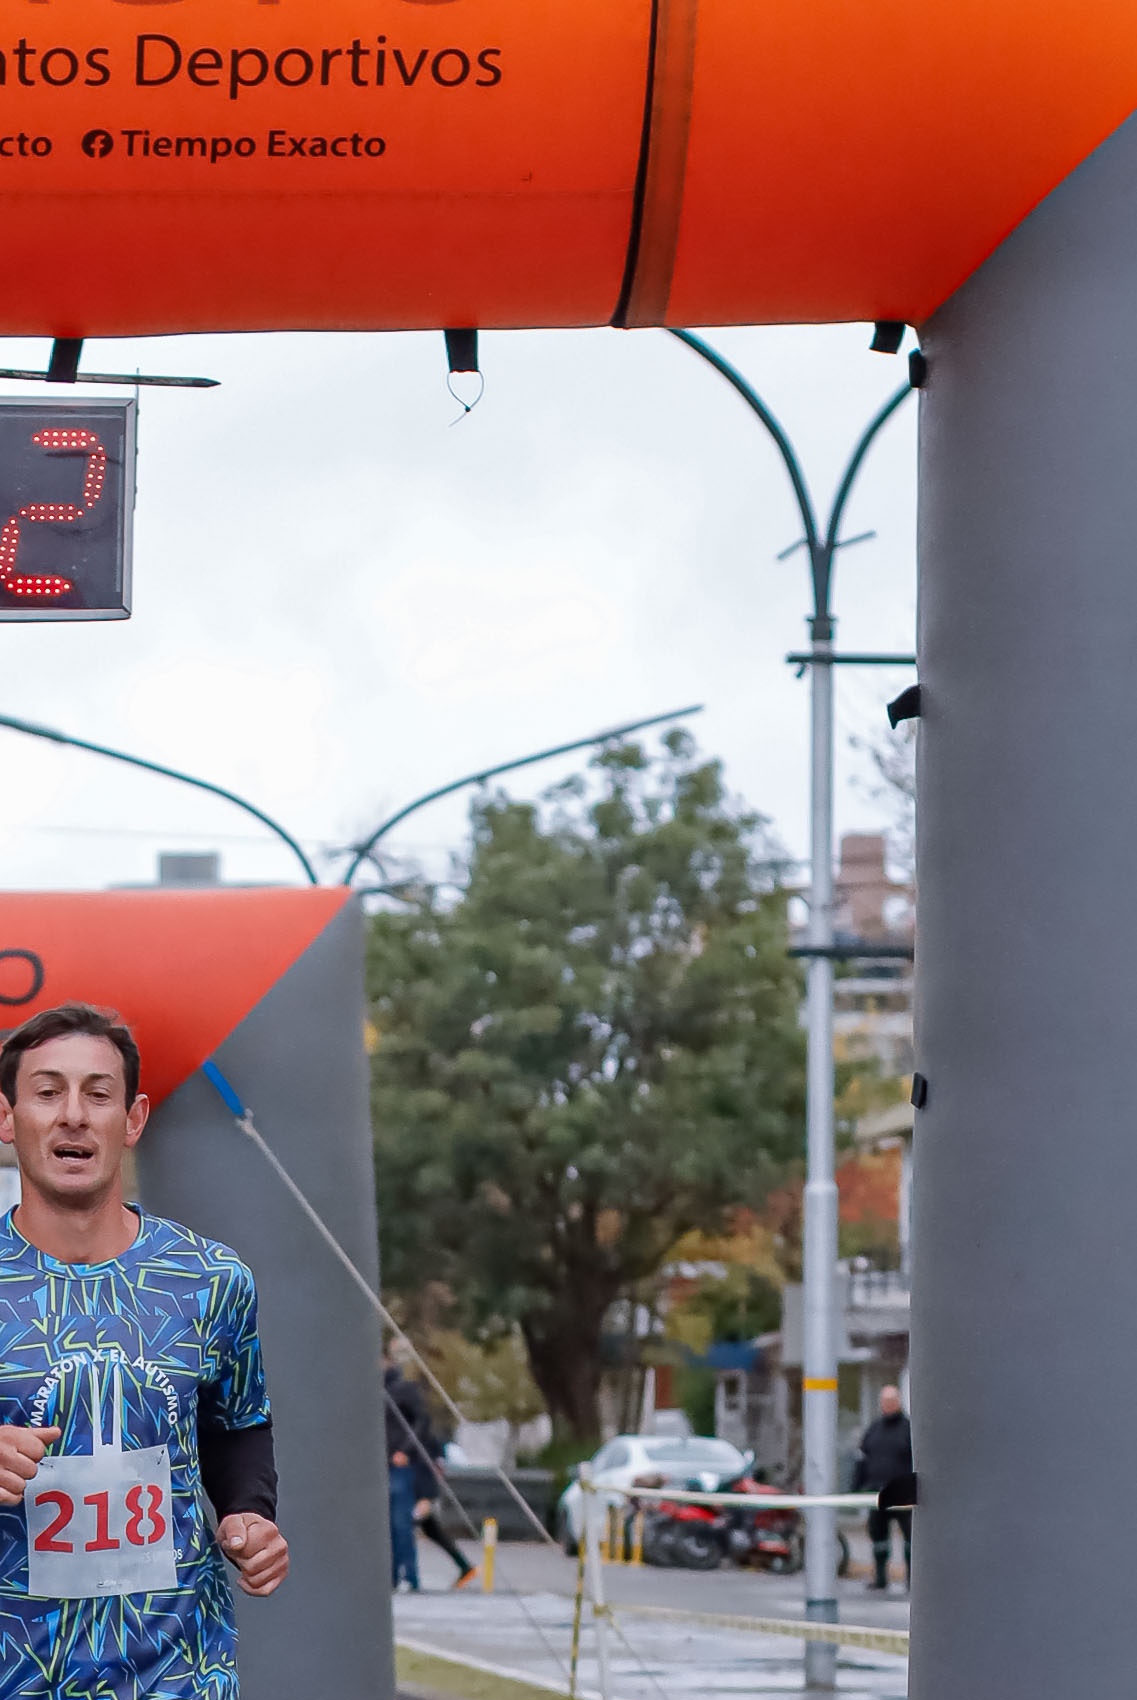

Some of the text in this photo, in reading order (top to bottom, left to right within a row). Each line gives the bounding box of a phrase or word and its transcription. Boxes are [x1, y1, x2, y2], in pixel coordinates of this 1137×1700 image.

[135, 34, 502, 100] Deportivos
[121, 129, 386, 164] Tiempo Exacto
[93, 1349, 105, 1362] X
[110, 1349, 128, 1364] EL
[132, 1356, 178, 1425] AUTISMO
[33, 1484, 167, 1553] 218
